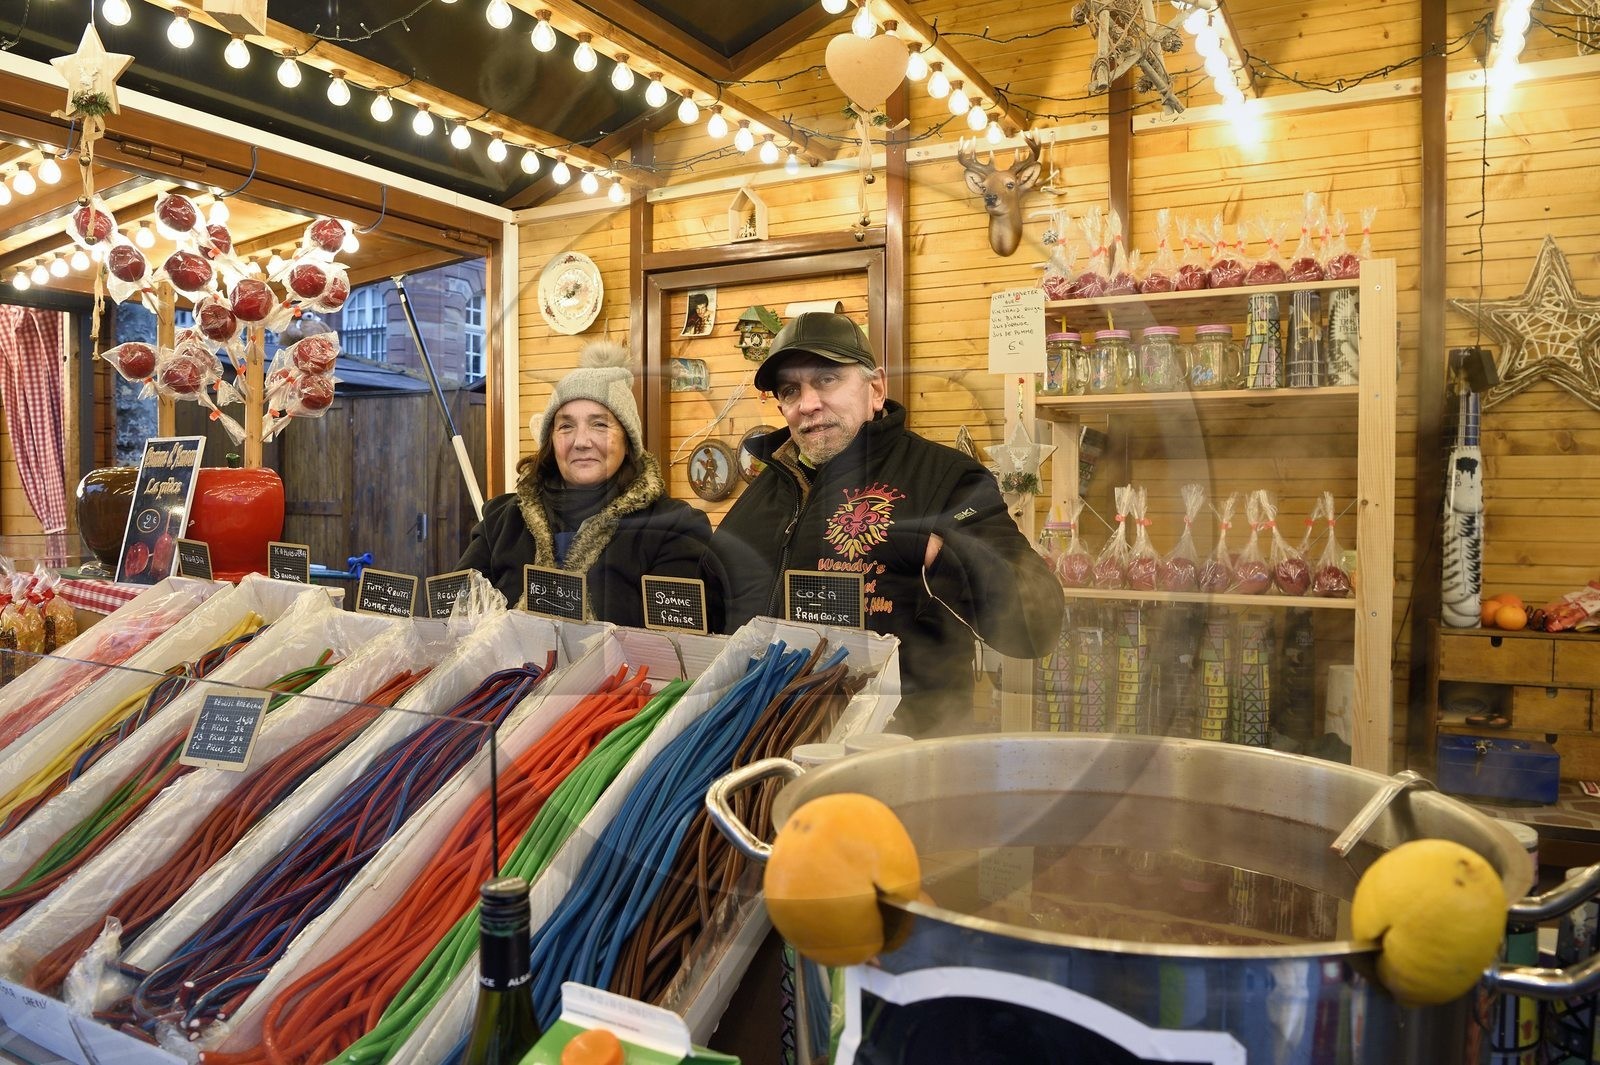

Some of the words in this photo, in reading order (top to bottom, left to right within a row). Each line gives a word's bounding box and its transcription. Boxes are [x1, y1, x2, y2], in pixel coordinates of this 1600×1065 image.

[817, 558, 887, 574] Wendy's
[556, 586, 581, 601] BULL
[655, 591, 692, 608] POMME
[796, 588, 837, 600] COCA
[193, 733, 203, 741] 13
